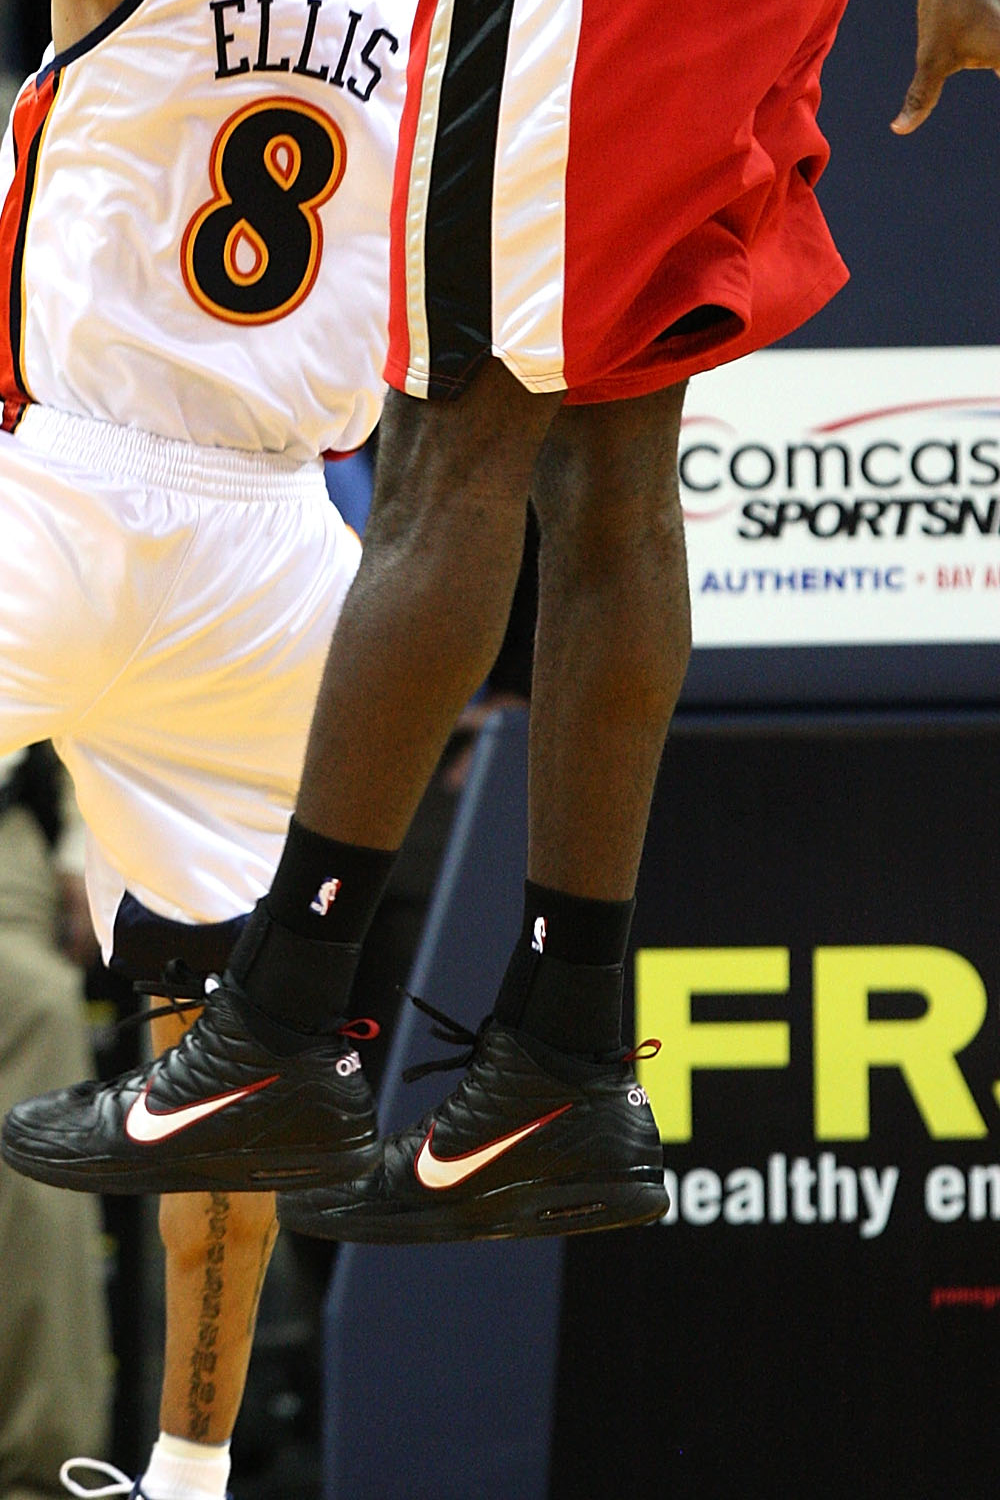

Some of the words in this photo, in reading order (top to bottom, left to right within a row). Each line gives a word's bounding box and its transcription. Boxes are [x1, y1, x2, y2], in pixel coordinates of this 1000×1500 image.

[180, 96, 347, 327] 8
[701, 566, 906, 594] AUTHENTIC
[635, 945, 1000, 1143] FR
[924, 1164, 1000, 1224] en
